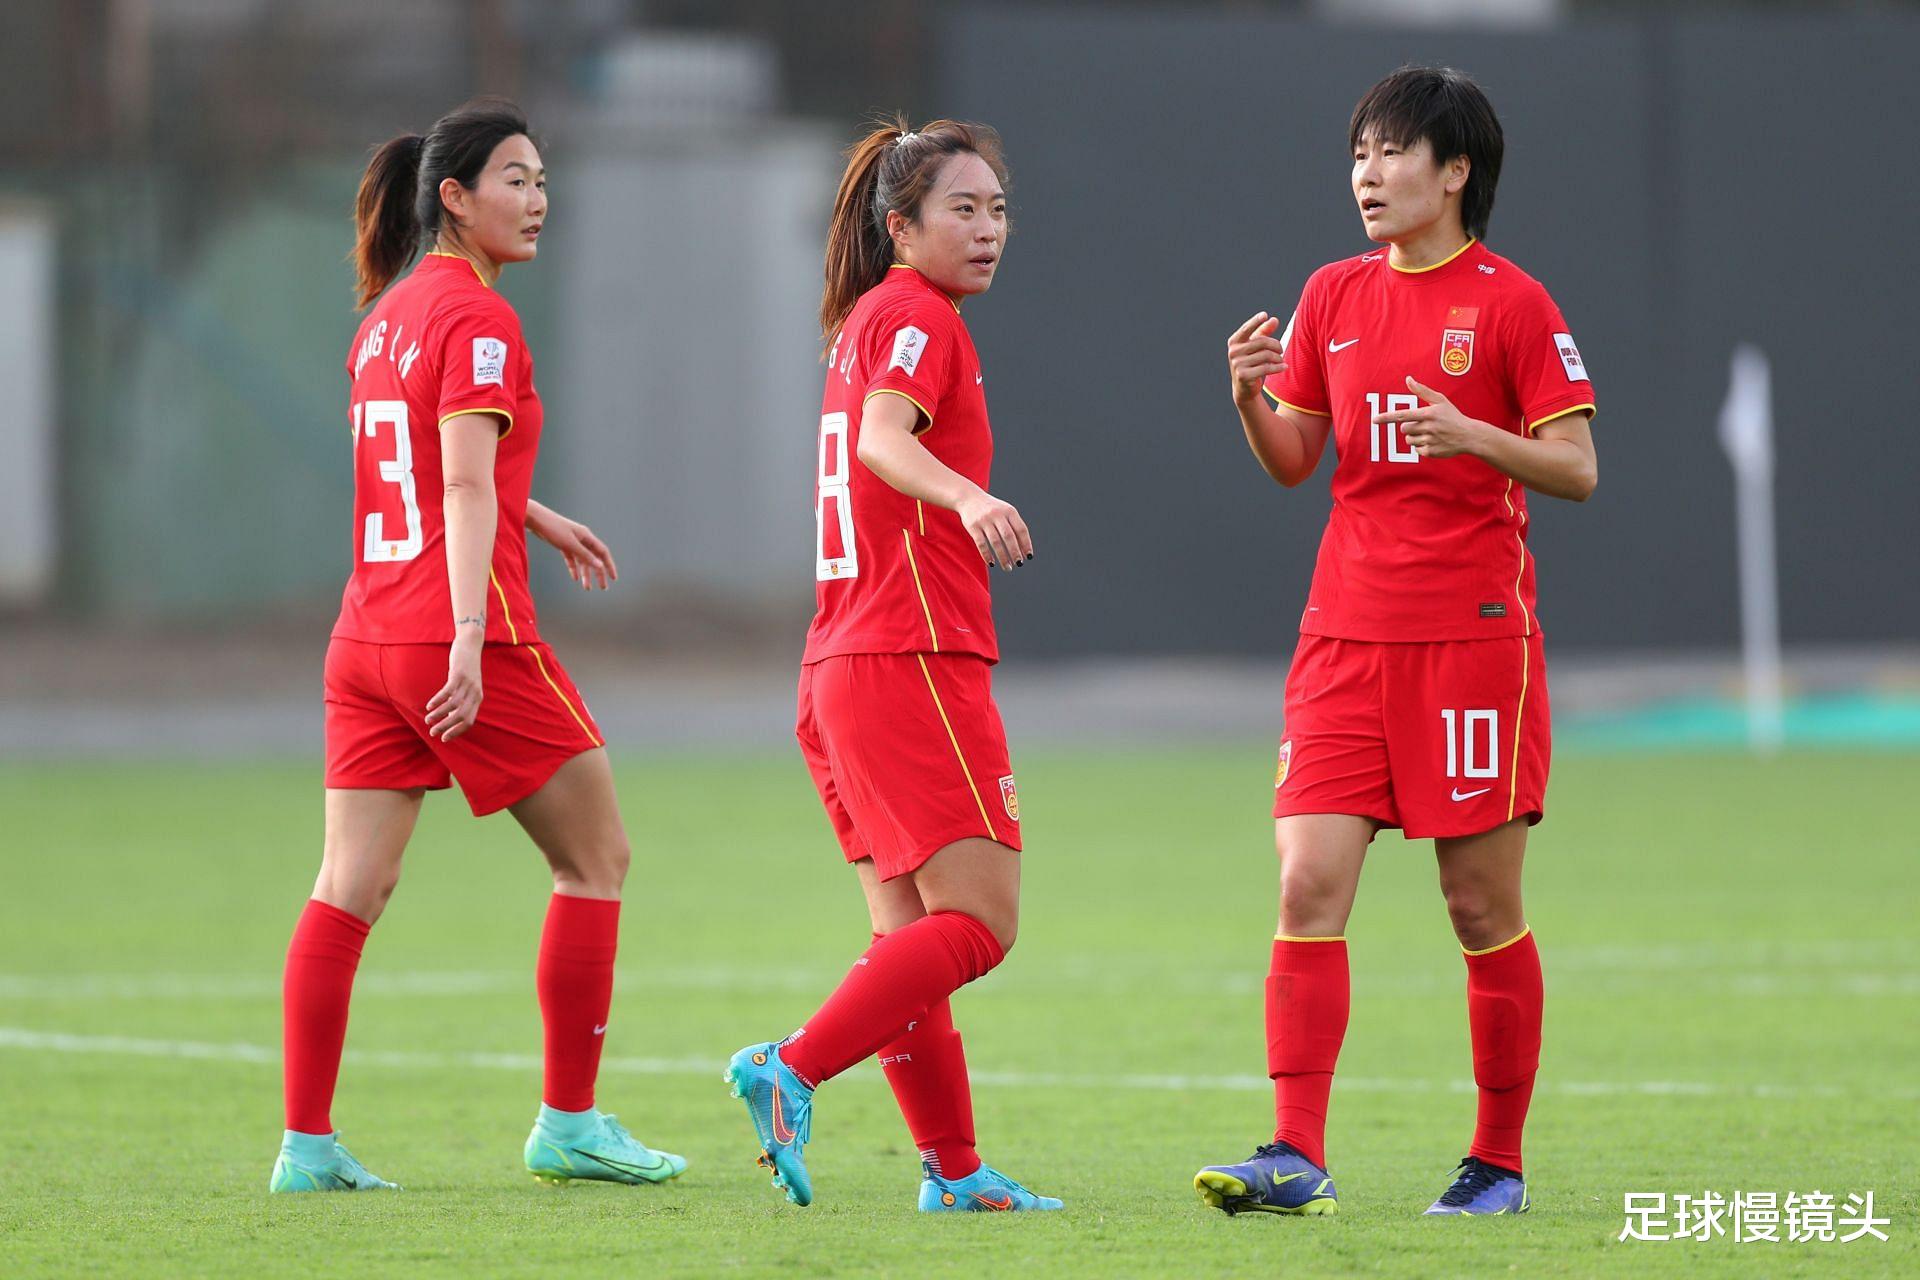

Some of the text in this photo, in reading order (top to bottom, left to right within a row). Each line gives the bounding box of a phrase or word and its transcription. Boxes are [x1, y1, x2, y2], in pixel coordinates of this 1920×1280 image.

[1447, 334, 1470, 343] CFA
[1366, 392, 1419, 463] 10
[1441, 709, 1499, 778] 10
